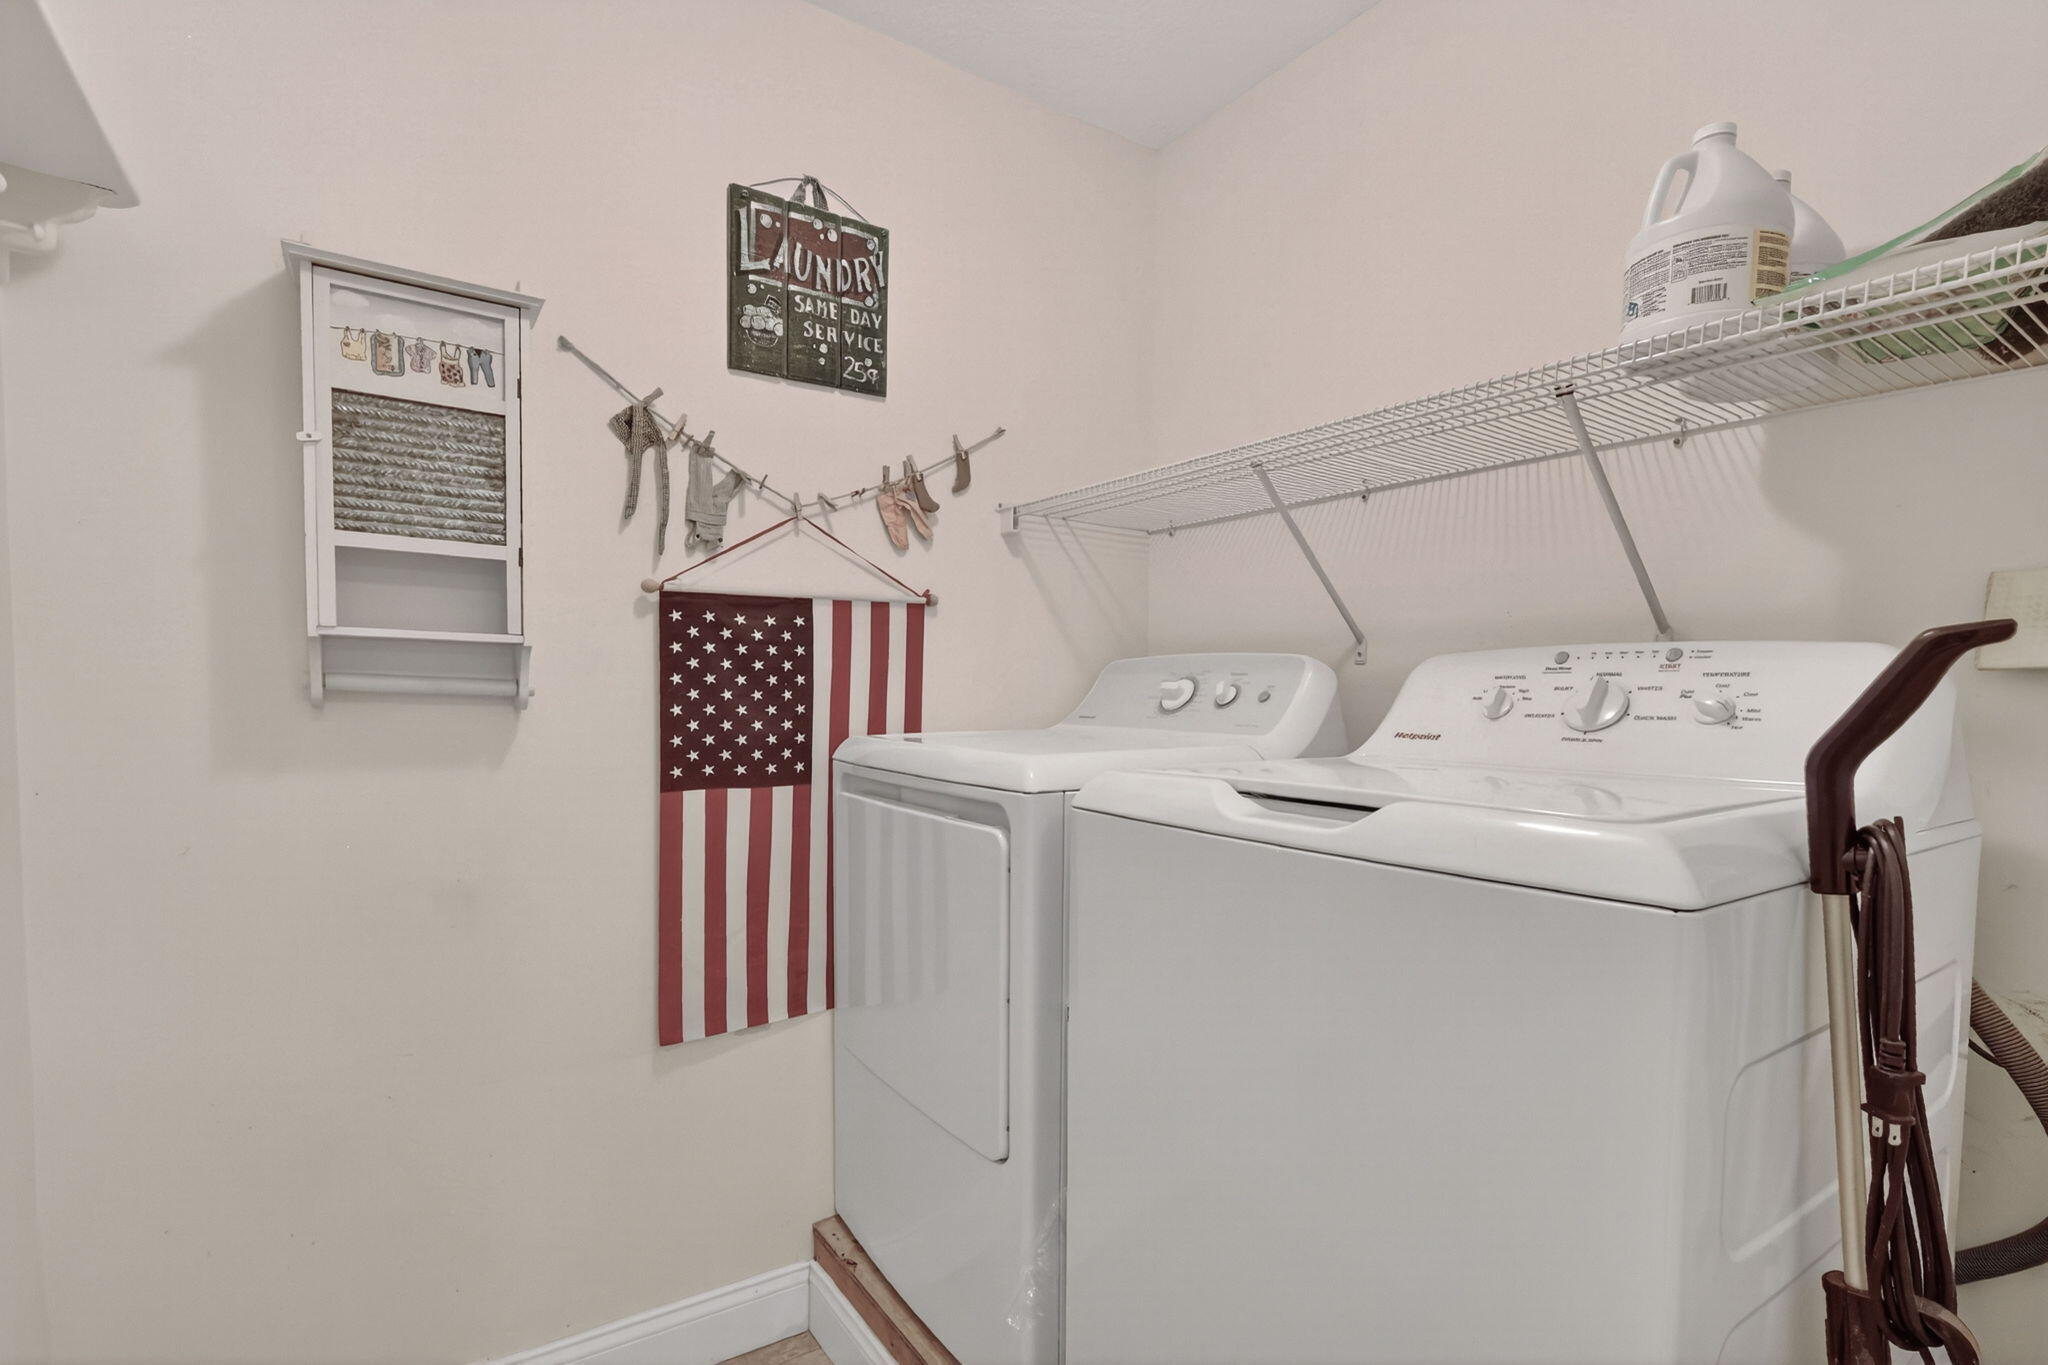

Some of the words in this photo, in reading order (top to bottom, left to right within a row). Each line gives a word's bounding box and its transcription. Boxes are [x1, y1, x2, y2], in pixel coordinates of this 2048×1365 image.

[738, 206, 886, 290] LAUNDRY
[794, 295, 838, 320] SAME
[850, 309, 883, 329] DAY
